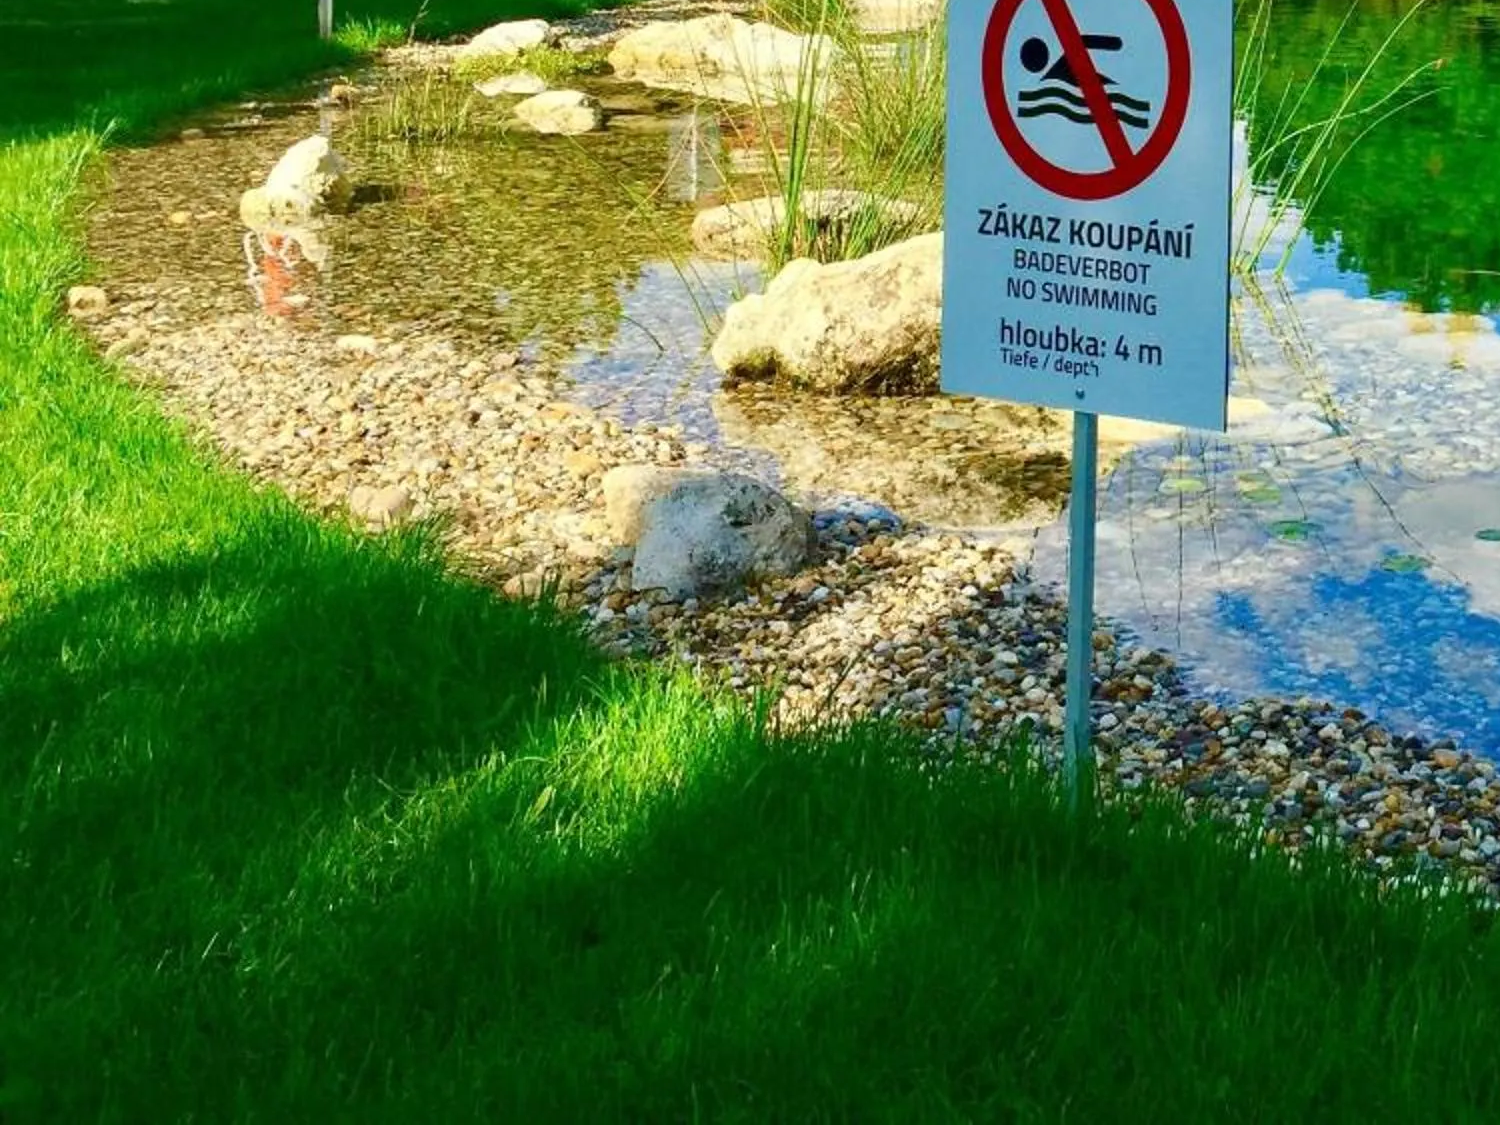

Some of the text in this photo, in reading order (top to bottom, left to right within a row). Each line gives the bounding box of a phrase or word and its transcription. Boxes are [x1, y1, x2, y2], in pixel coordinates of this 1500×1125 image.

[978, 203, 1195, 259] ZÁKAZ KOUPÁNÍ
[1013, 248, 1151, 285] BADEVERBOT
[1006, 277, 1158, 316] NO SWIMMING
[999, 317, 1163, 366] hloubka: 4 m
[1000, 347, 1038, 369] Tiefe
[1042, 354, 1050, 371] /
